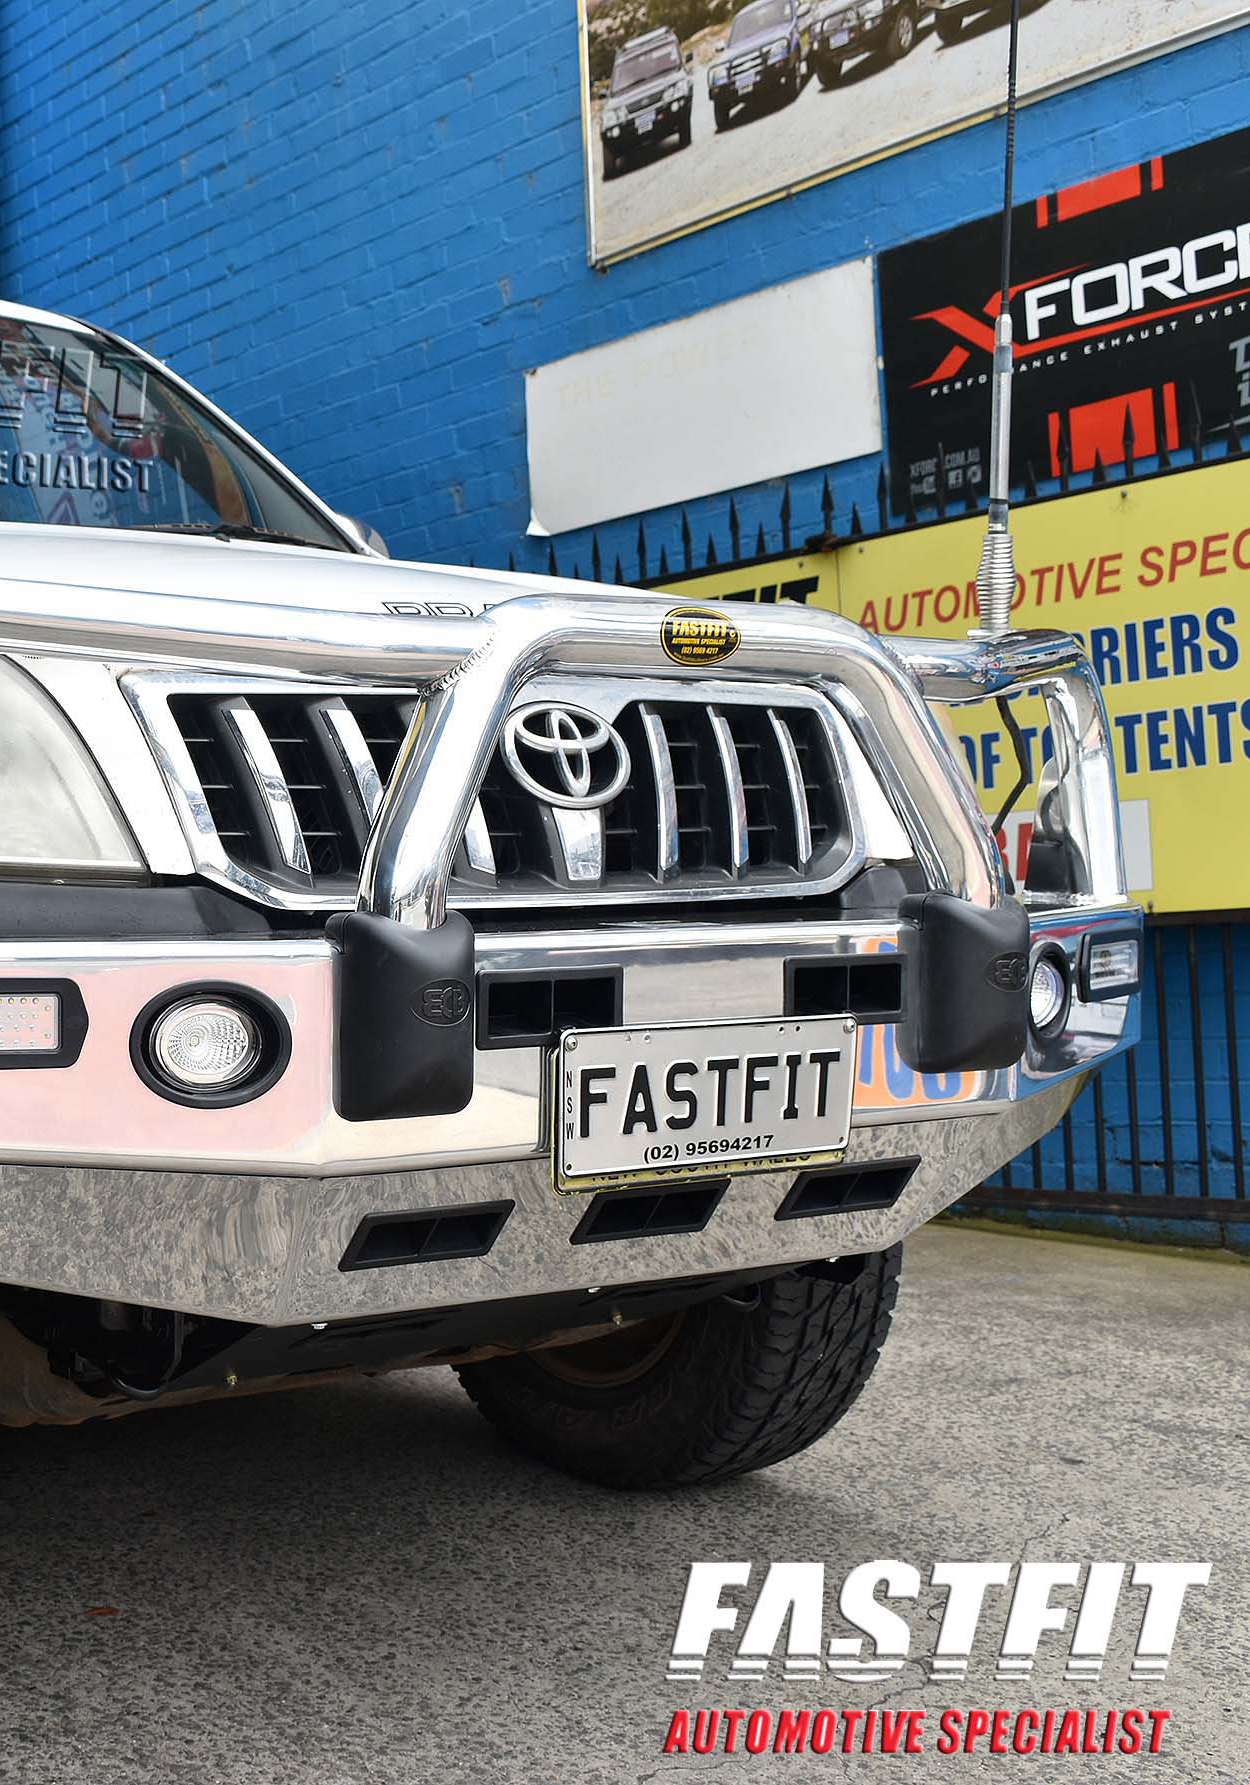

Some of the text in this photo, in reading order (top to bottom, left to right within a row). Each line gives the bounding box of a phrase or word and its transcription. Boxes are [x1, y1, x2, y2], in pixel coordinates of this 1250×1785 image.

[910, 222, 1250, 388] XFORC
[930, 351, 1069, 397] PERFOANCE
[1083, 320, 1179, 356] EXHAUST
[672, 620, 729, 637] FASTFIT
[1115, 700, 1250, 774] TENT
[579, 1050, 841, 1139] FASTFIT
[643, 1134, 774, 1164] (02) 95694217
